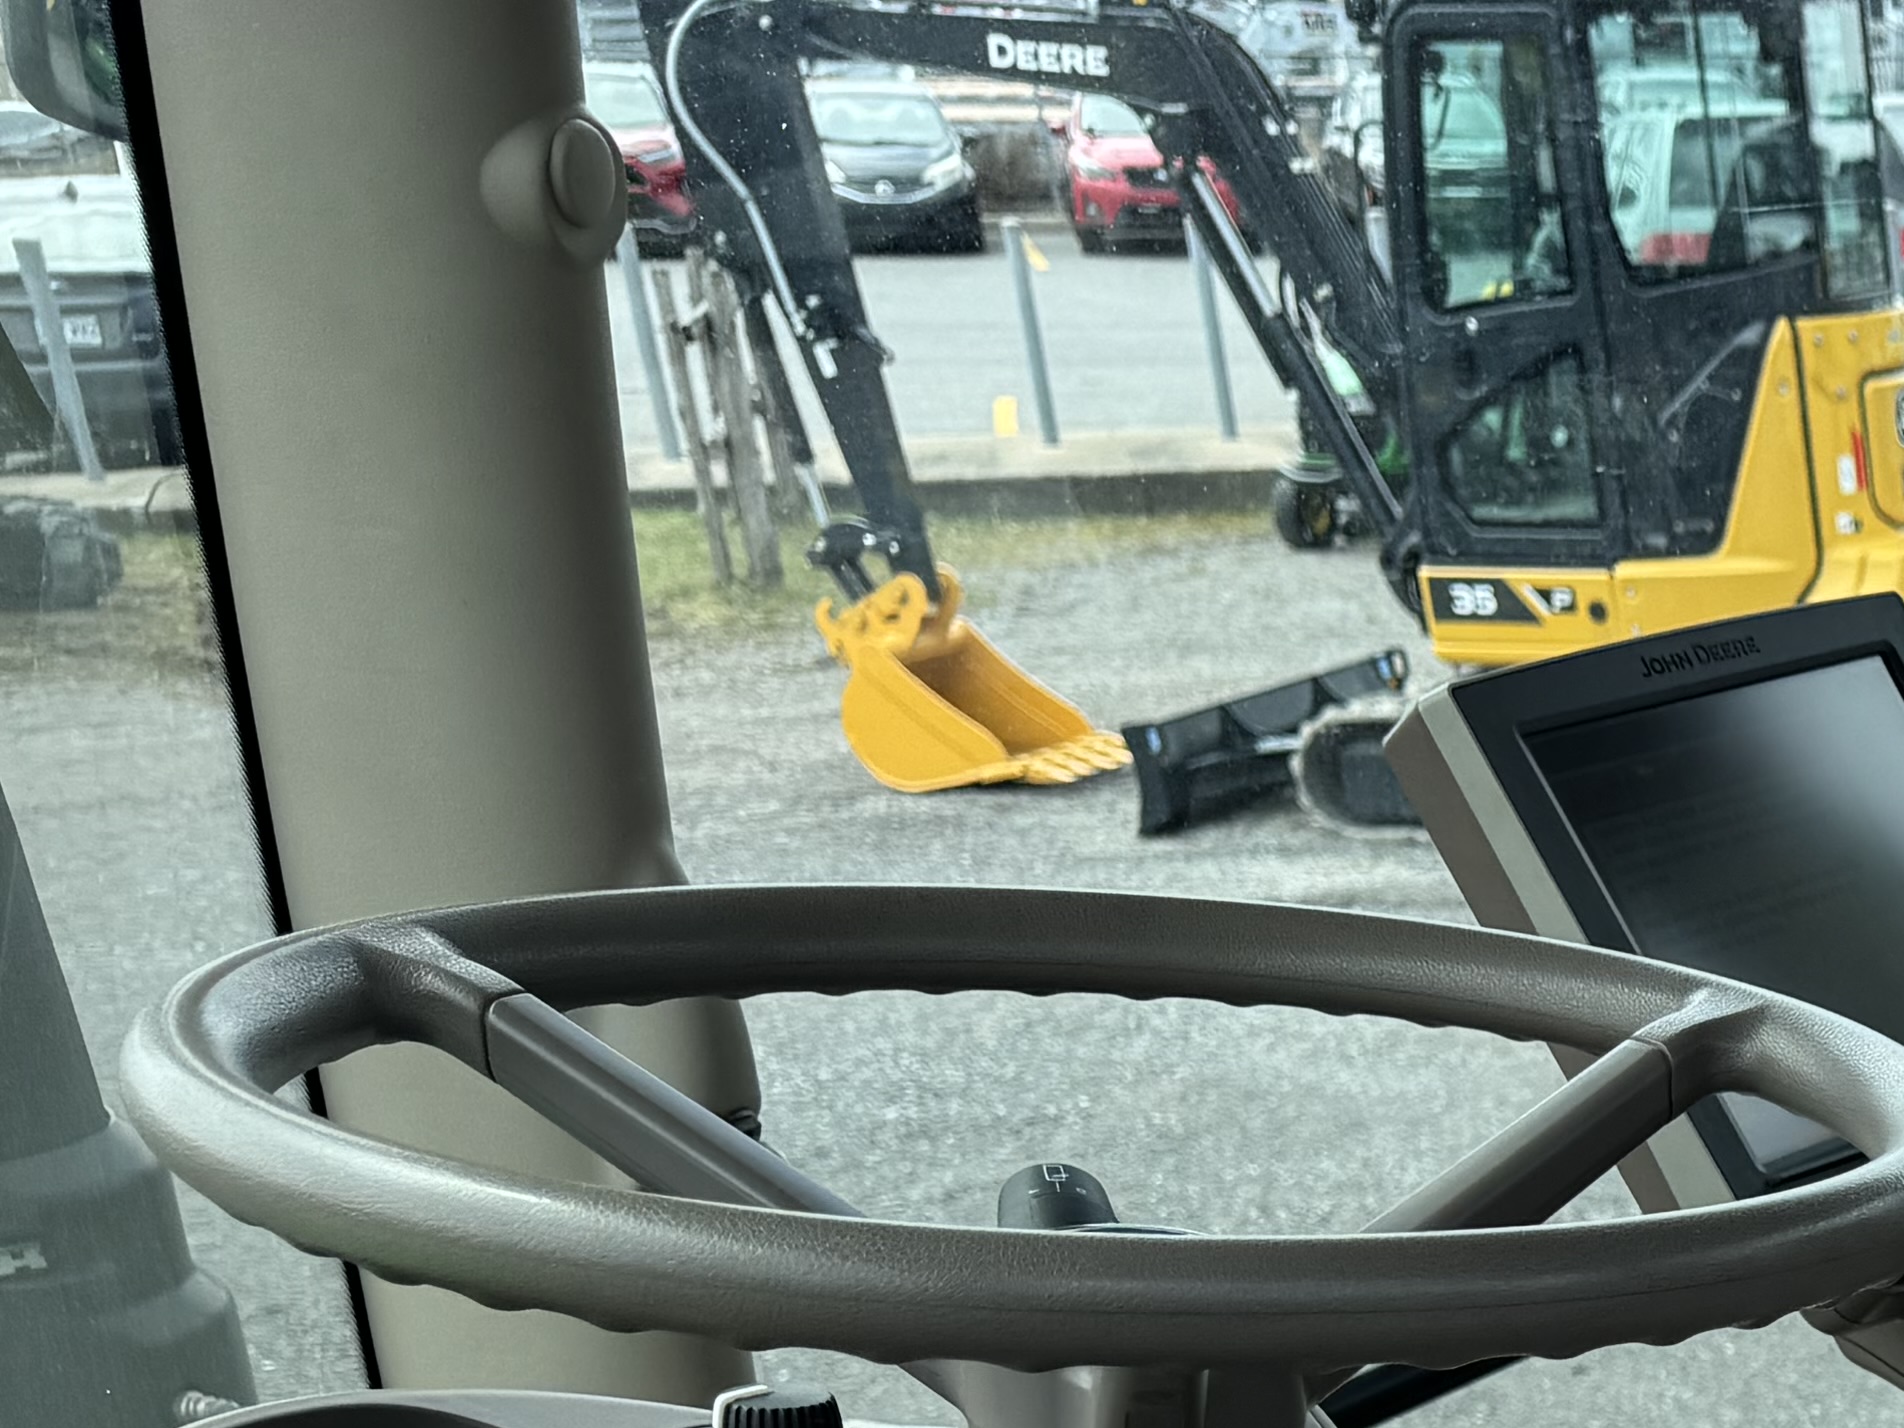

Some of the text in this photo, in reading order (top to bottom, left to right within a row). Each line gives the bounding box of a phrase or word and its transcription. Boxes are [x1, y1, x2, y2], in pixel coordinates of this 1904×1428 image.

[986, 32, 1109, 77] DEERE
[1450, 583, 1498, 617] 35
[1640, 636, 1761, 678] JOHN DEERE
